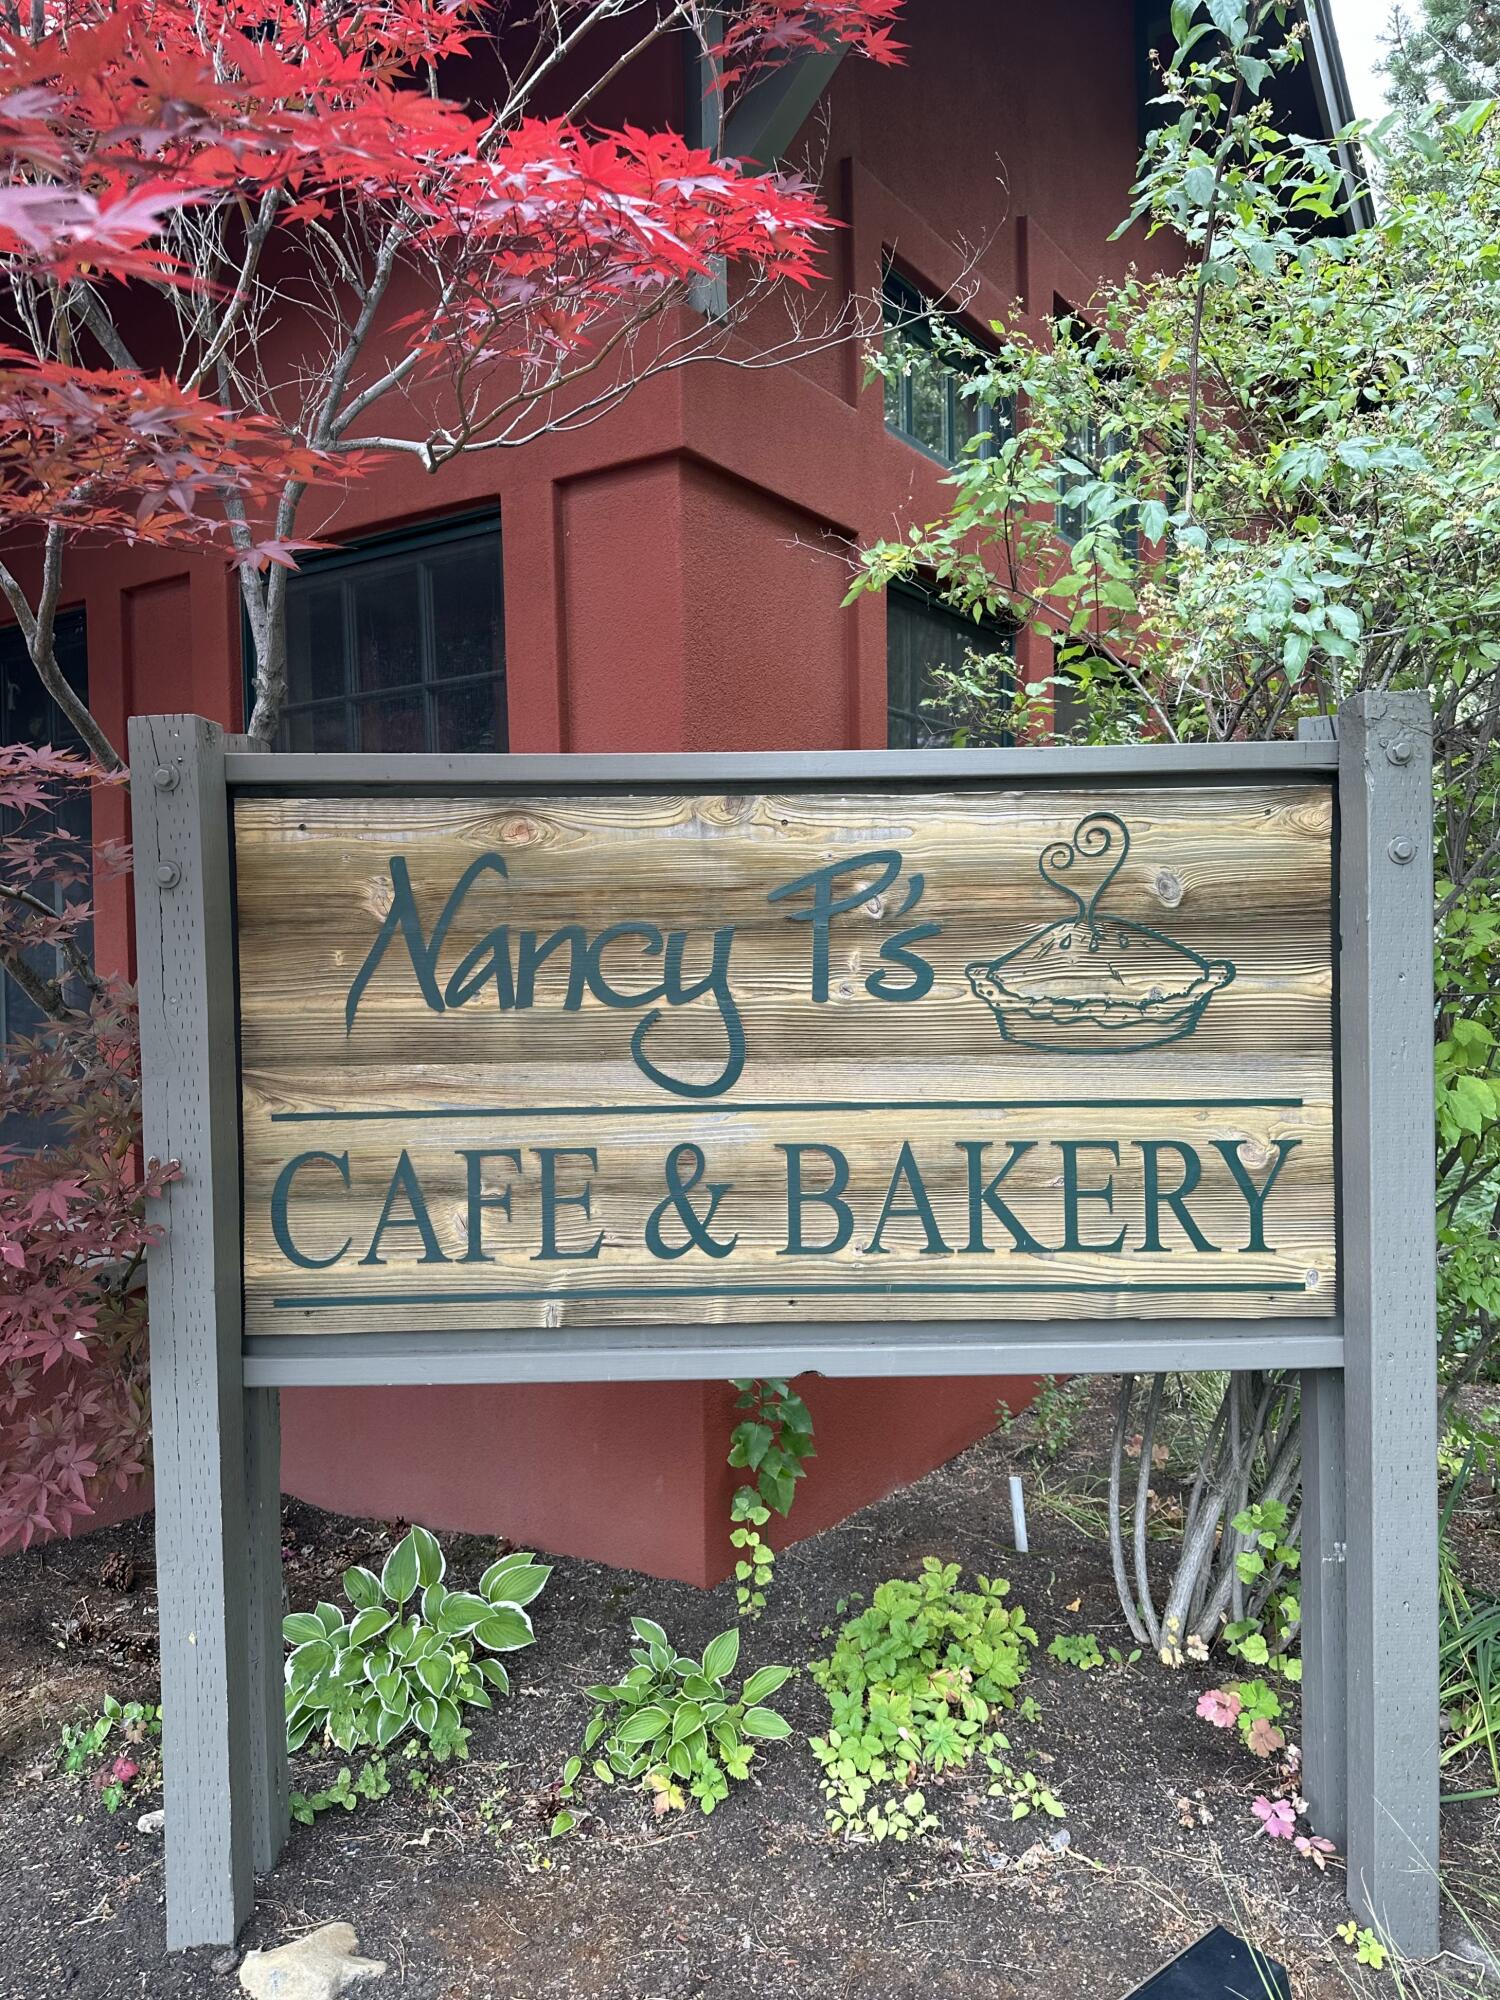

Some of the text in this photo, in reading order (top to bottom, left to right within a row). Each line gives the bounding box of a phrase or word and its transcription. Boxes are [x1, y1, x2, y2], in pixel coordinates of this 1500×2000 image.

[345, 850, 941, 1098] Nancy P's
[271, 1139, 1302, 1269] CAFE & BAKERY
